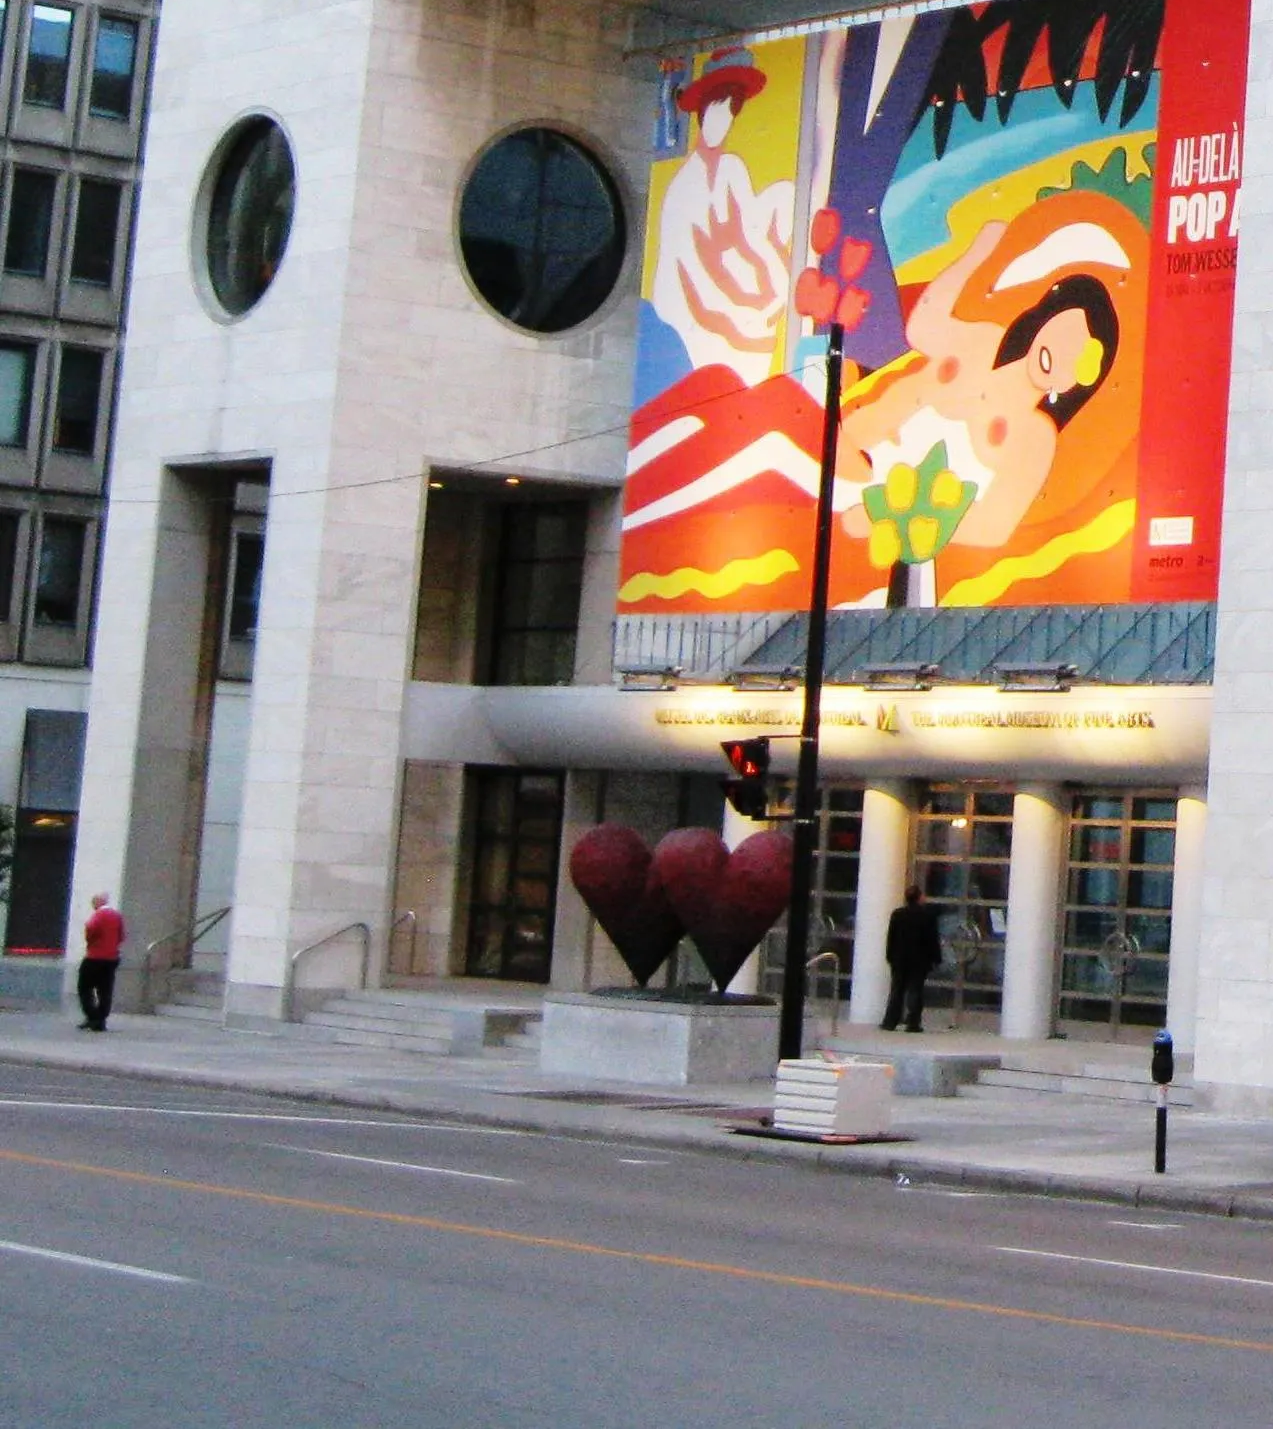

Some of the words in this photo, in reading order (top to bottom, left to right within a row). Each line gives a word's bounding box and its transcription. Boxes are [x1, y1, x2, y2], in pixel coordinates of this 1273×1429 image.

[1171, 122, 1239, 188] AU-DELÀ
[1167, 191, 1227, 244] POP
[1167, 252, 1191, 274] TOM
[1149, 555, 1184, 568] metro
